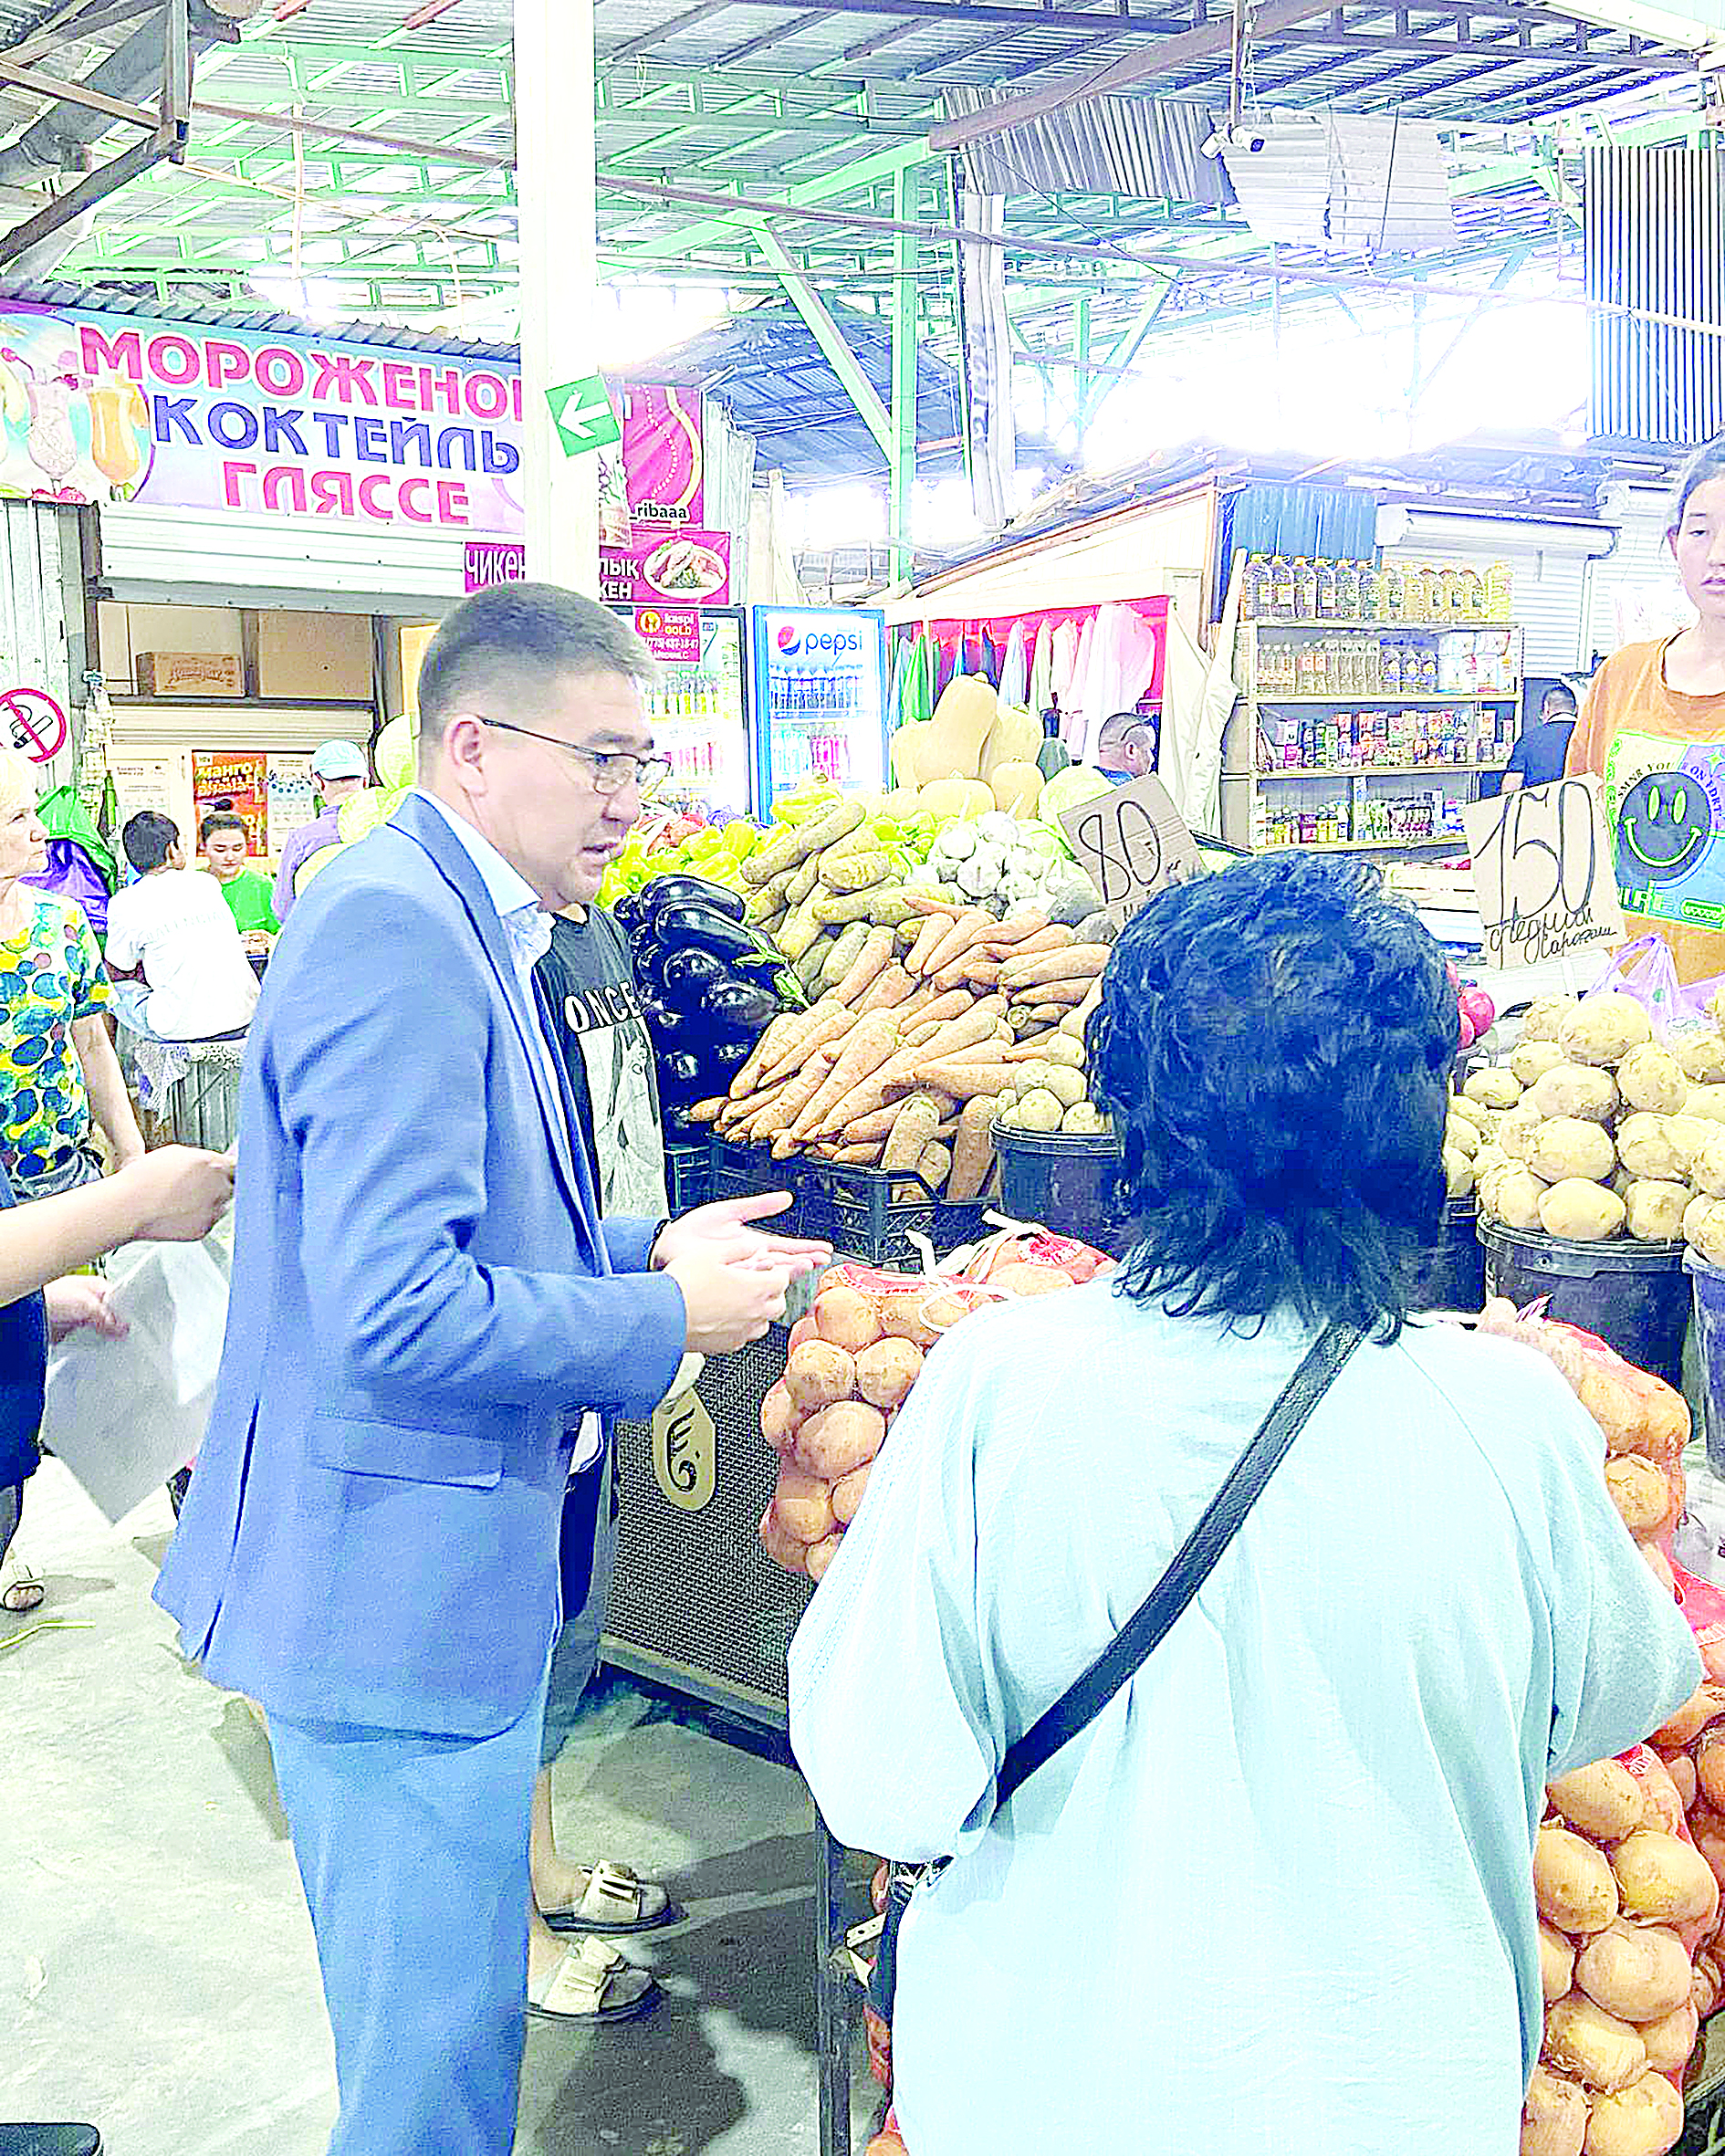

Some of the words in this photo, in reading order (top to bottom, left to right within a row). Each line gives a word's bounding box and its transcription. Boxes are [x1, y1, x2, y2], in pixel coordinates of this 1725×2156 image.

[79, 325, 523, 423] МОРОЖЕНО
[153, 394, 521, 475] КОКТЕЙЛЬ
[223, 460, 471, 527] ГЛЯССЕ
[805, 630, 862, 655] pepsi
[1078, 800, 1162, 905] 80
[1474, 780, 1595, 929] 150
[563, 979, 642, 1034] ONCE
